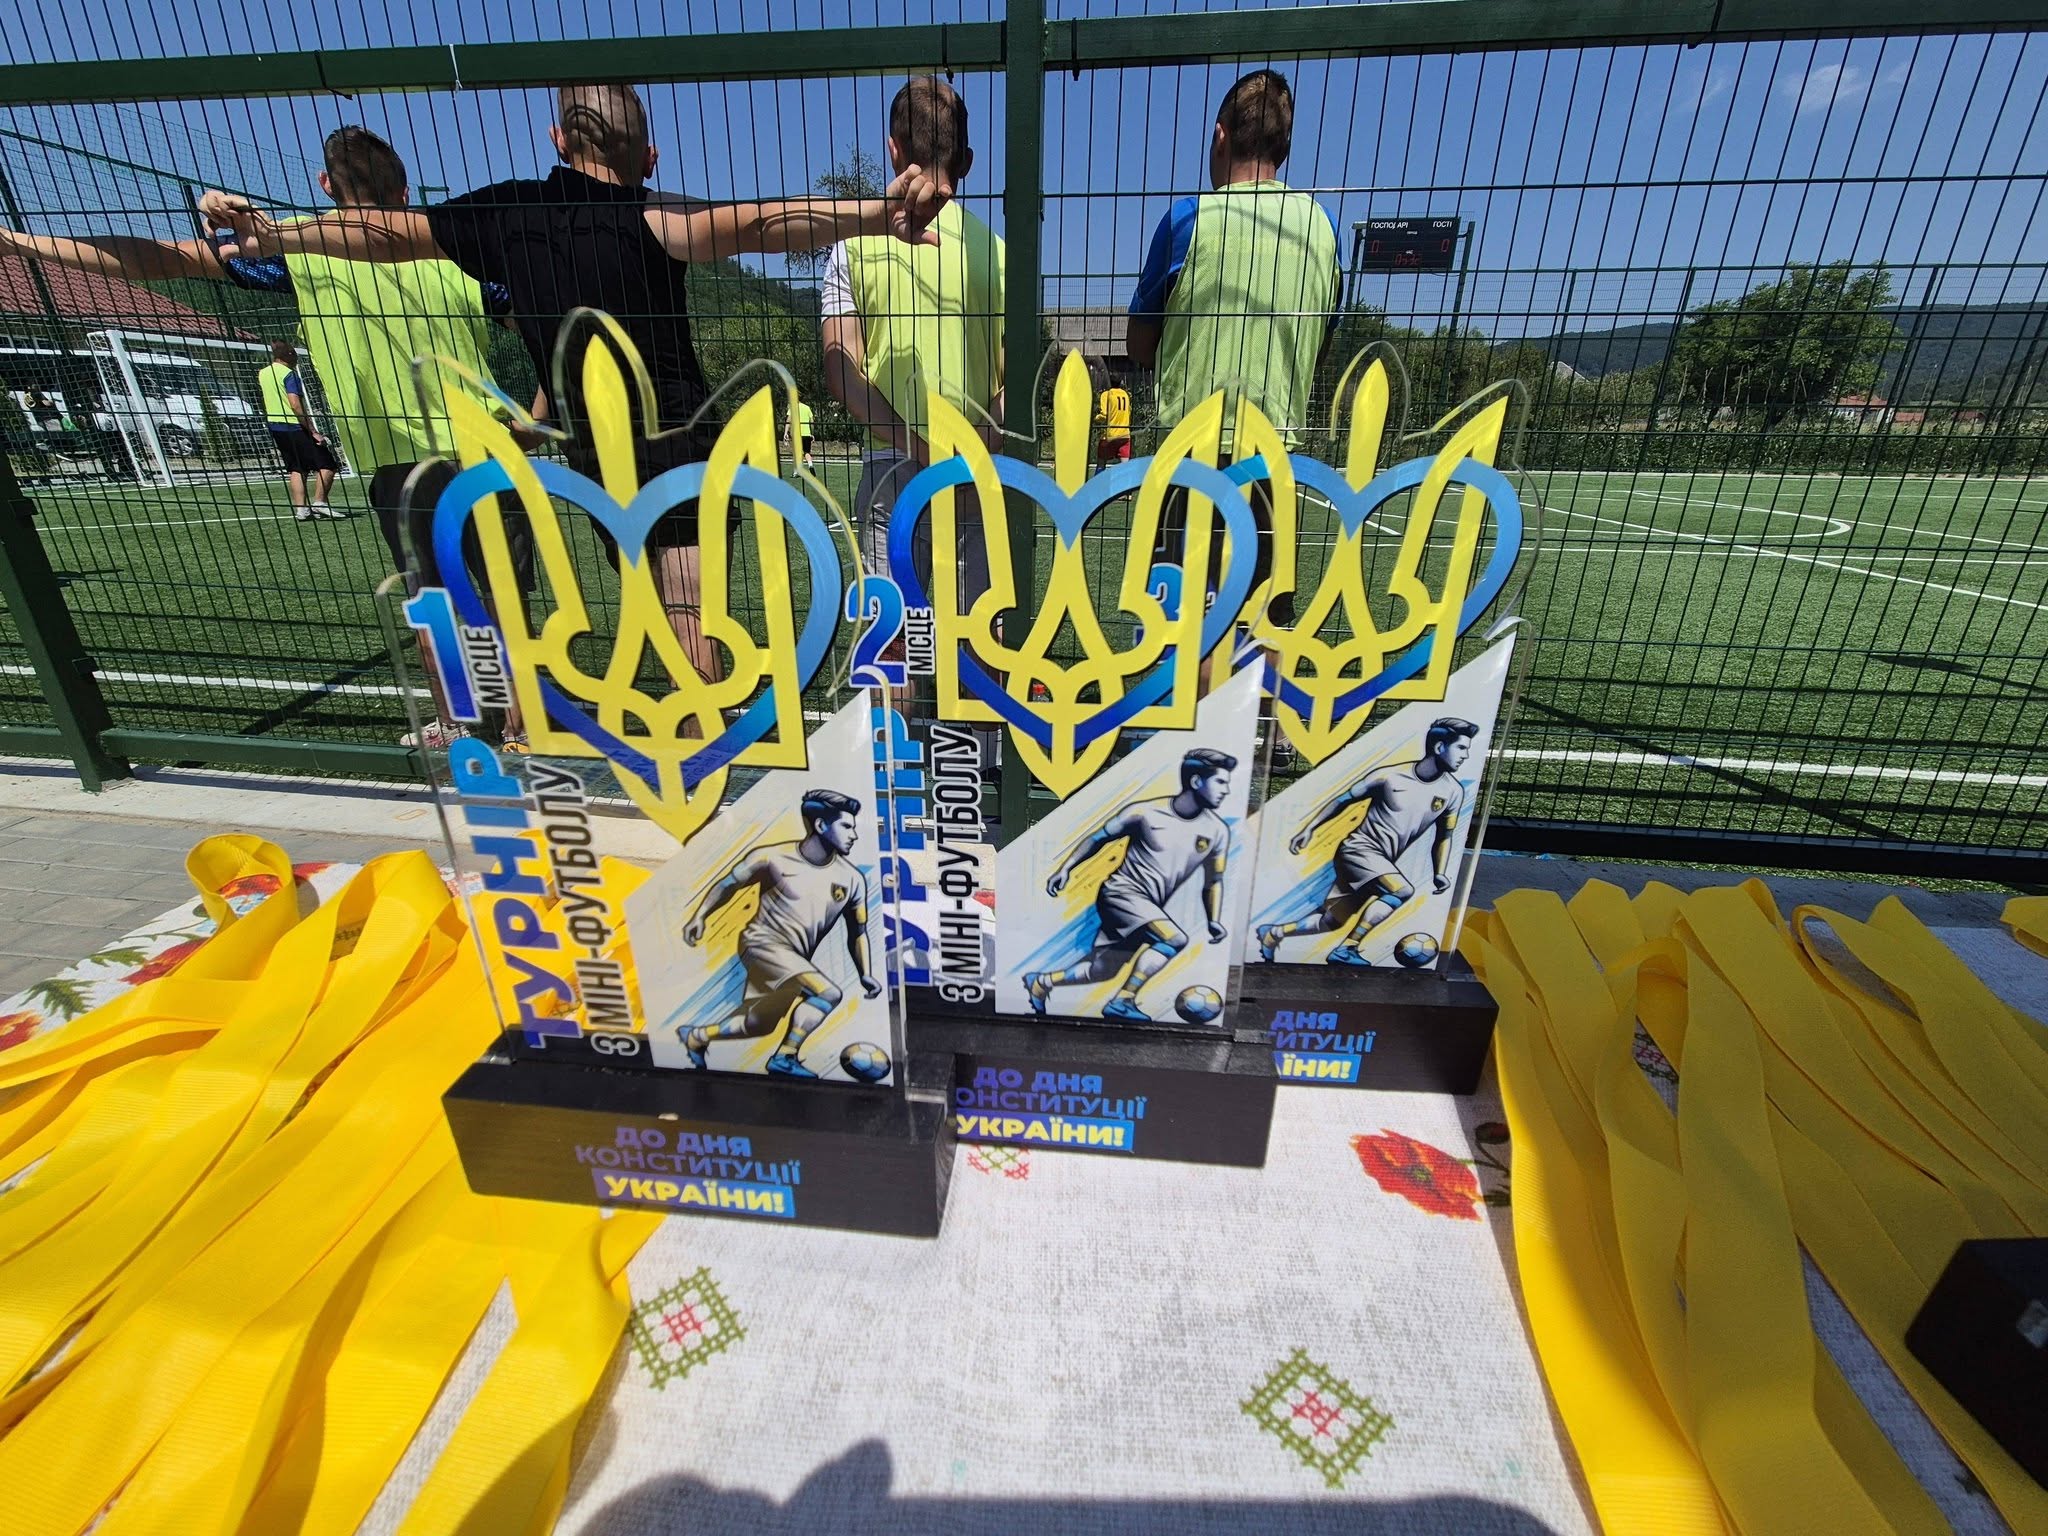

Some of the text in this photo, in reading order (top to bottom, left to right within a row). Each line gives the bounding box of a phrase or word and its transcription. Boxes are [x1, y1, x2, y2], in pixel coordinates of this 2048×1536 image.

[1117, 397, 1126, 411] 11
[847, 576, 906, 687] 2
[907, 607, 934, 674] МІСЦЕ
[404, 589, 480, 720] 1
[464, 627, 511, 705] МІСЦЕ
[934, 729, 981, 976] МІНІ-ФУТБОЛУ
[449, 737, 582, 1048] ТУРНІР
[527, 764, 632, 1028] МІНІ-ФУТБОЛУ
[1270, 1010, 1338, 1031] ДНЯ
[973, 1066, 1103, 1094] ДО ДНЯ
[1276, 1053, 1352, 1079] ЇНИ!
[956, 1087, 1148, 1120] ОНСТИТУЦІЇ
[615, 1127, 753, 1157] ДО ДНЯ
[957, 1114, 1125, 1146] УКРАЇНИ!
[575, 1145, 801, 1185] КОНСТИТУЦІЇ
[604, 1174, 785, 1213] УКРАЇНИ!
